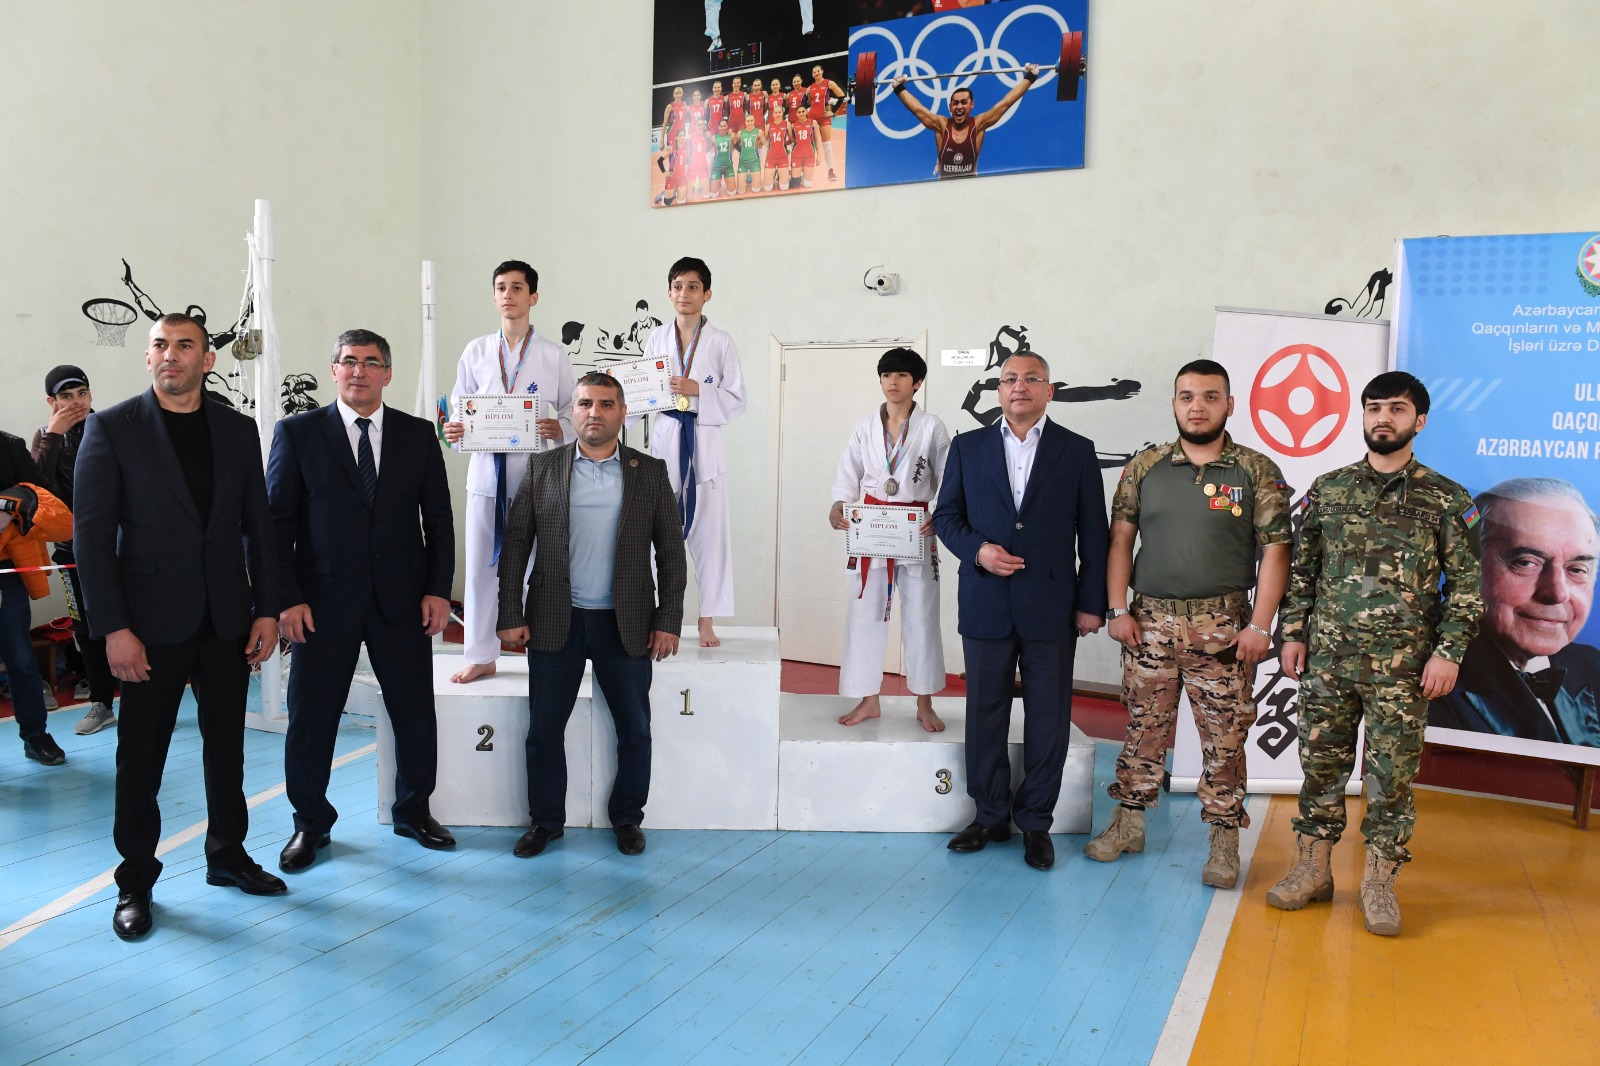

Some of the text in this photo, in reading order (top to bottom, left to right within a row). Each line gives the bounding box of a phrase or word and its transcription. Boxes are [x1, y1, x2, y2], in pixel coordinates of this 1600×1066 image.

[815, 92, 820, 102] 2
[712, 104, 720, 113] 17
[733, 99, 741, 108] 10
[753, 101, 761, 110] 11
[772, 132, 782, 142] 14
[798, 129, 808, 140] 18
[697, 142, 702, 152] 6
[719, 142, 728, 153] 12
[743, 137, 753, 148] 16
[943, 163, 972, 172] AZERBAIJAN
[1471, 321, 1558, 337] Qaçqınların
[1563, 324, 1581, 333] və
[1508, 337, 1600, 354] İşləri üzrə D
[1552, 411, 1600, 434] QAÇQ
[1476, 438, 1589, 459] AZƏRBAYCAN
[680, 688, 694, 715] 1
[475, 724, 494, 751] 2
[935, 768, 952, 795] 3
